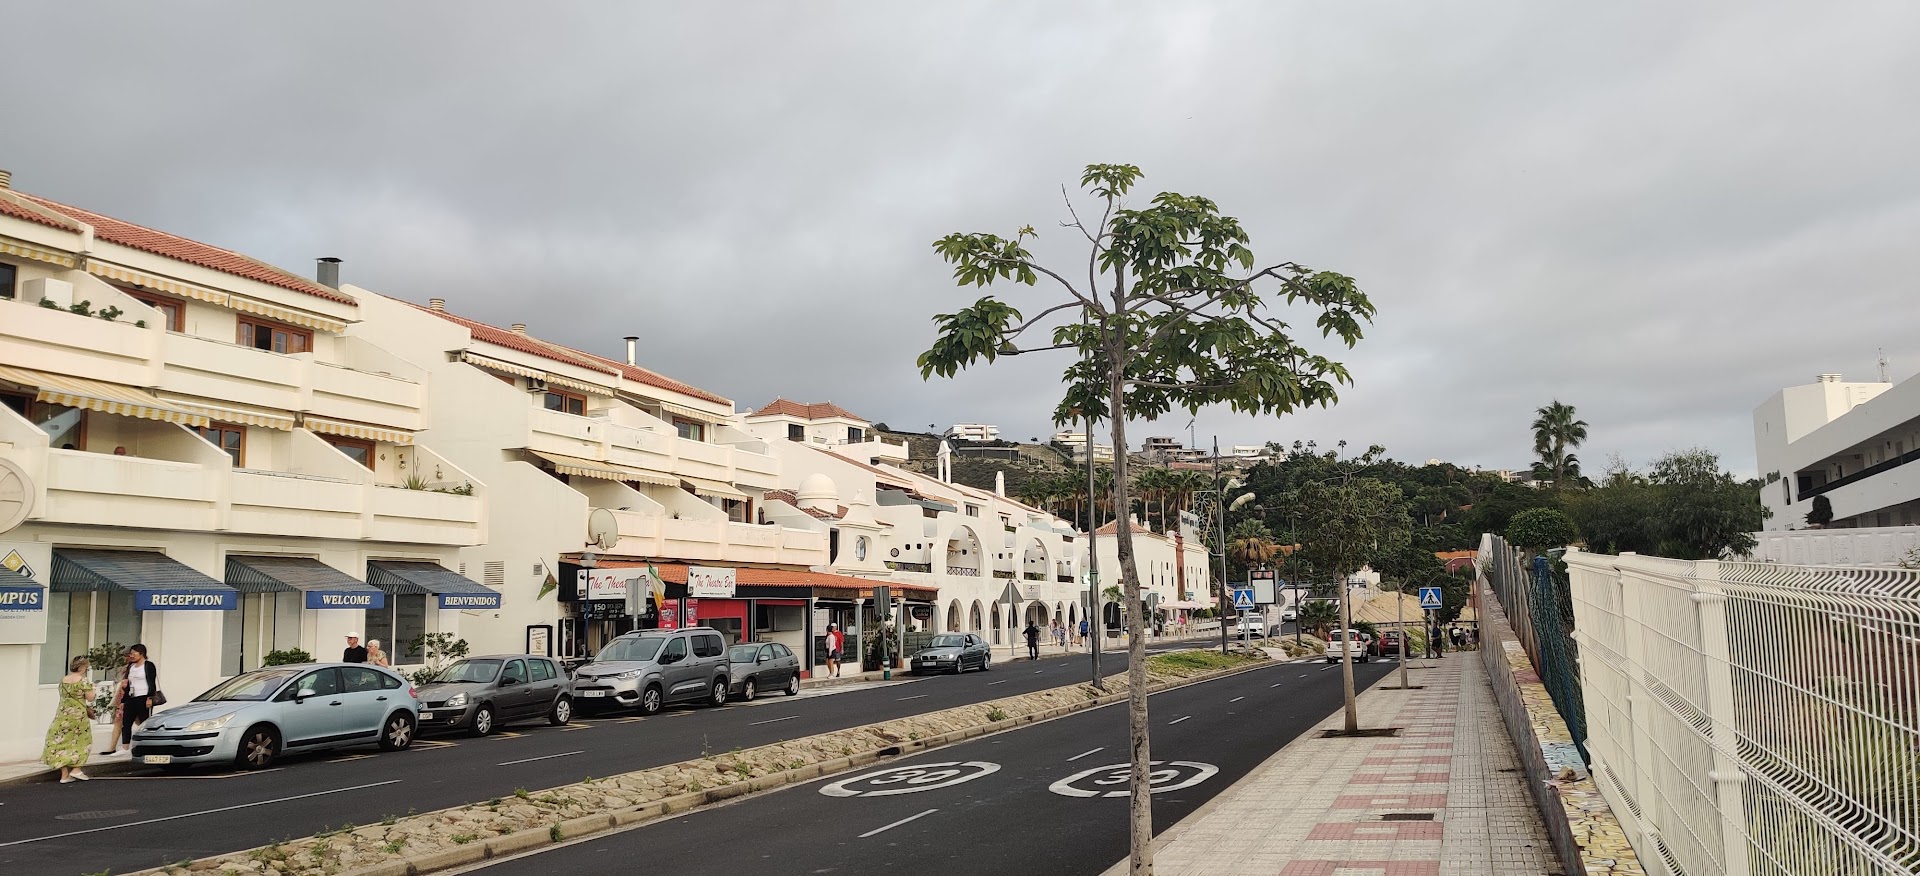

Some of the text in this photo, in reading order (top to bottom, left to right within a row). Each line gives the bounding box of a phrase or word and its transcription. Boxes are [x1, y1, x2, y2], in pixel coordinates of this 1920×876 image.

[588, 575, 602, 590] The
[695, 574, 733, 588] The Theatre Bar
[150, 594, 223, 606] RECEPTION
[322, 594, 371, 605] WELCOME
[444, 596, 497, 606] BIENVENIDOS
[869, 769, 961, 785] 30
